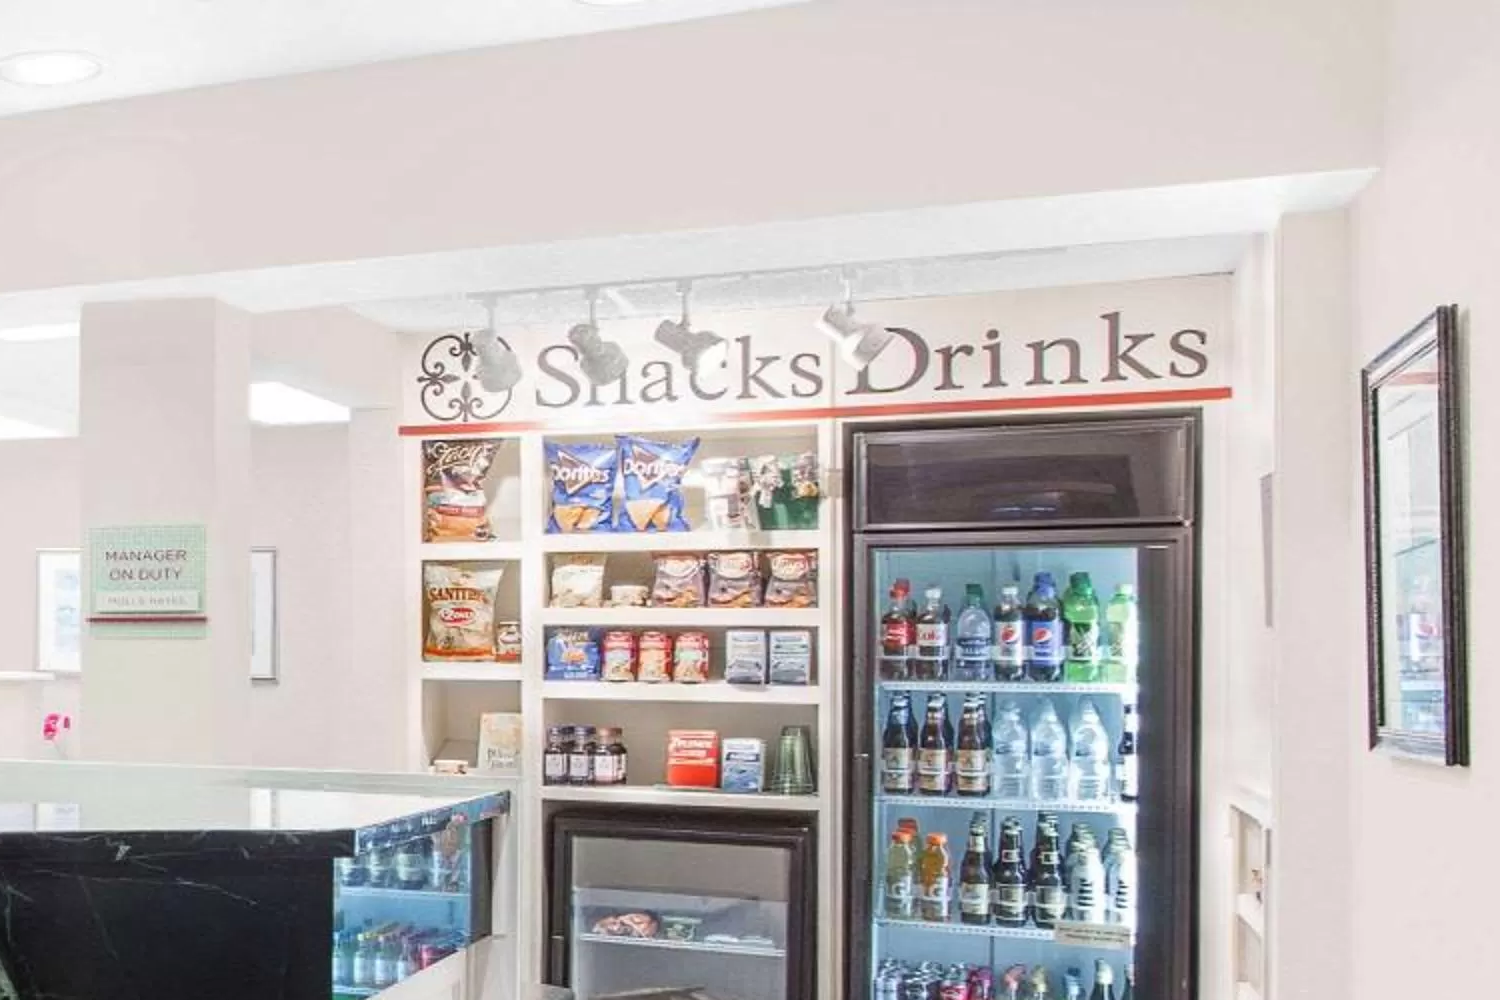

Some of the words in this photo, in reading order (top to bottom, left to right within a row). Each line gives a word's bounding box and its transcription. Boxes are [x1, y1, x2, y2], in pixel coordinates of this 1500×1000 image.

[845, 311, 1209, 396] Drinks
[104, 549, 188, 562] MANAGER
[108, 568, 134, 581] ON
[138, 566, 181, 581] DUTY
